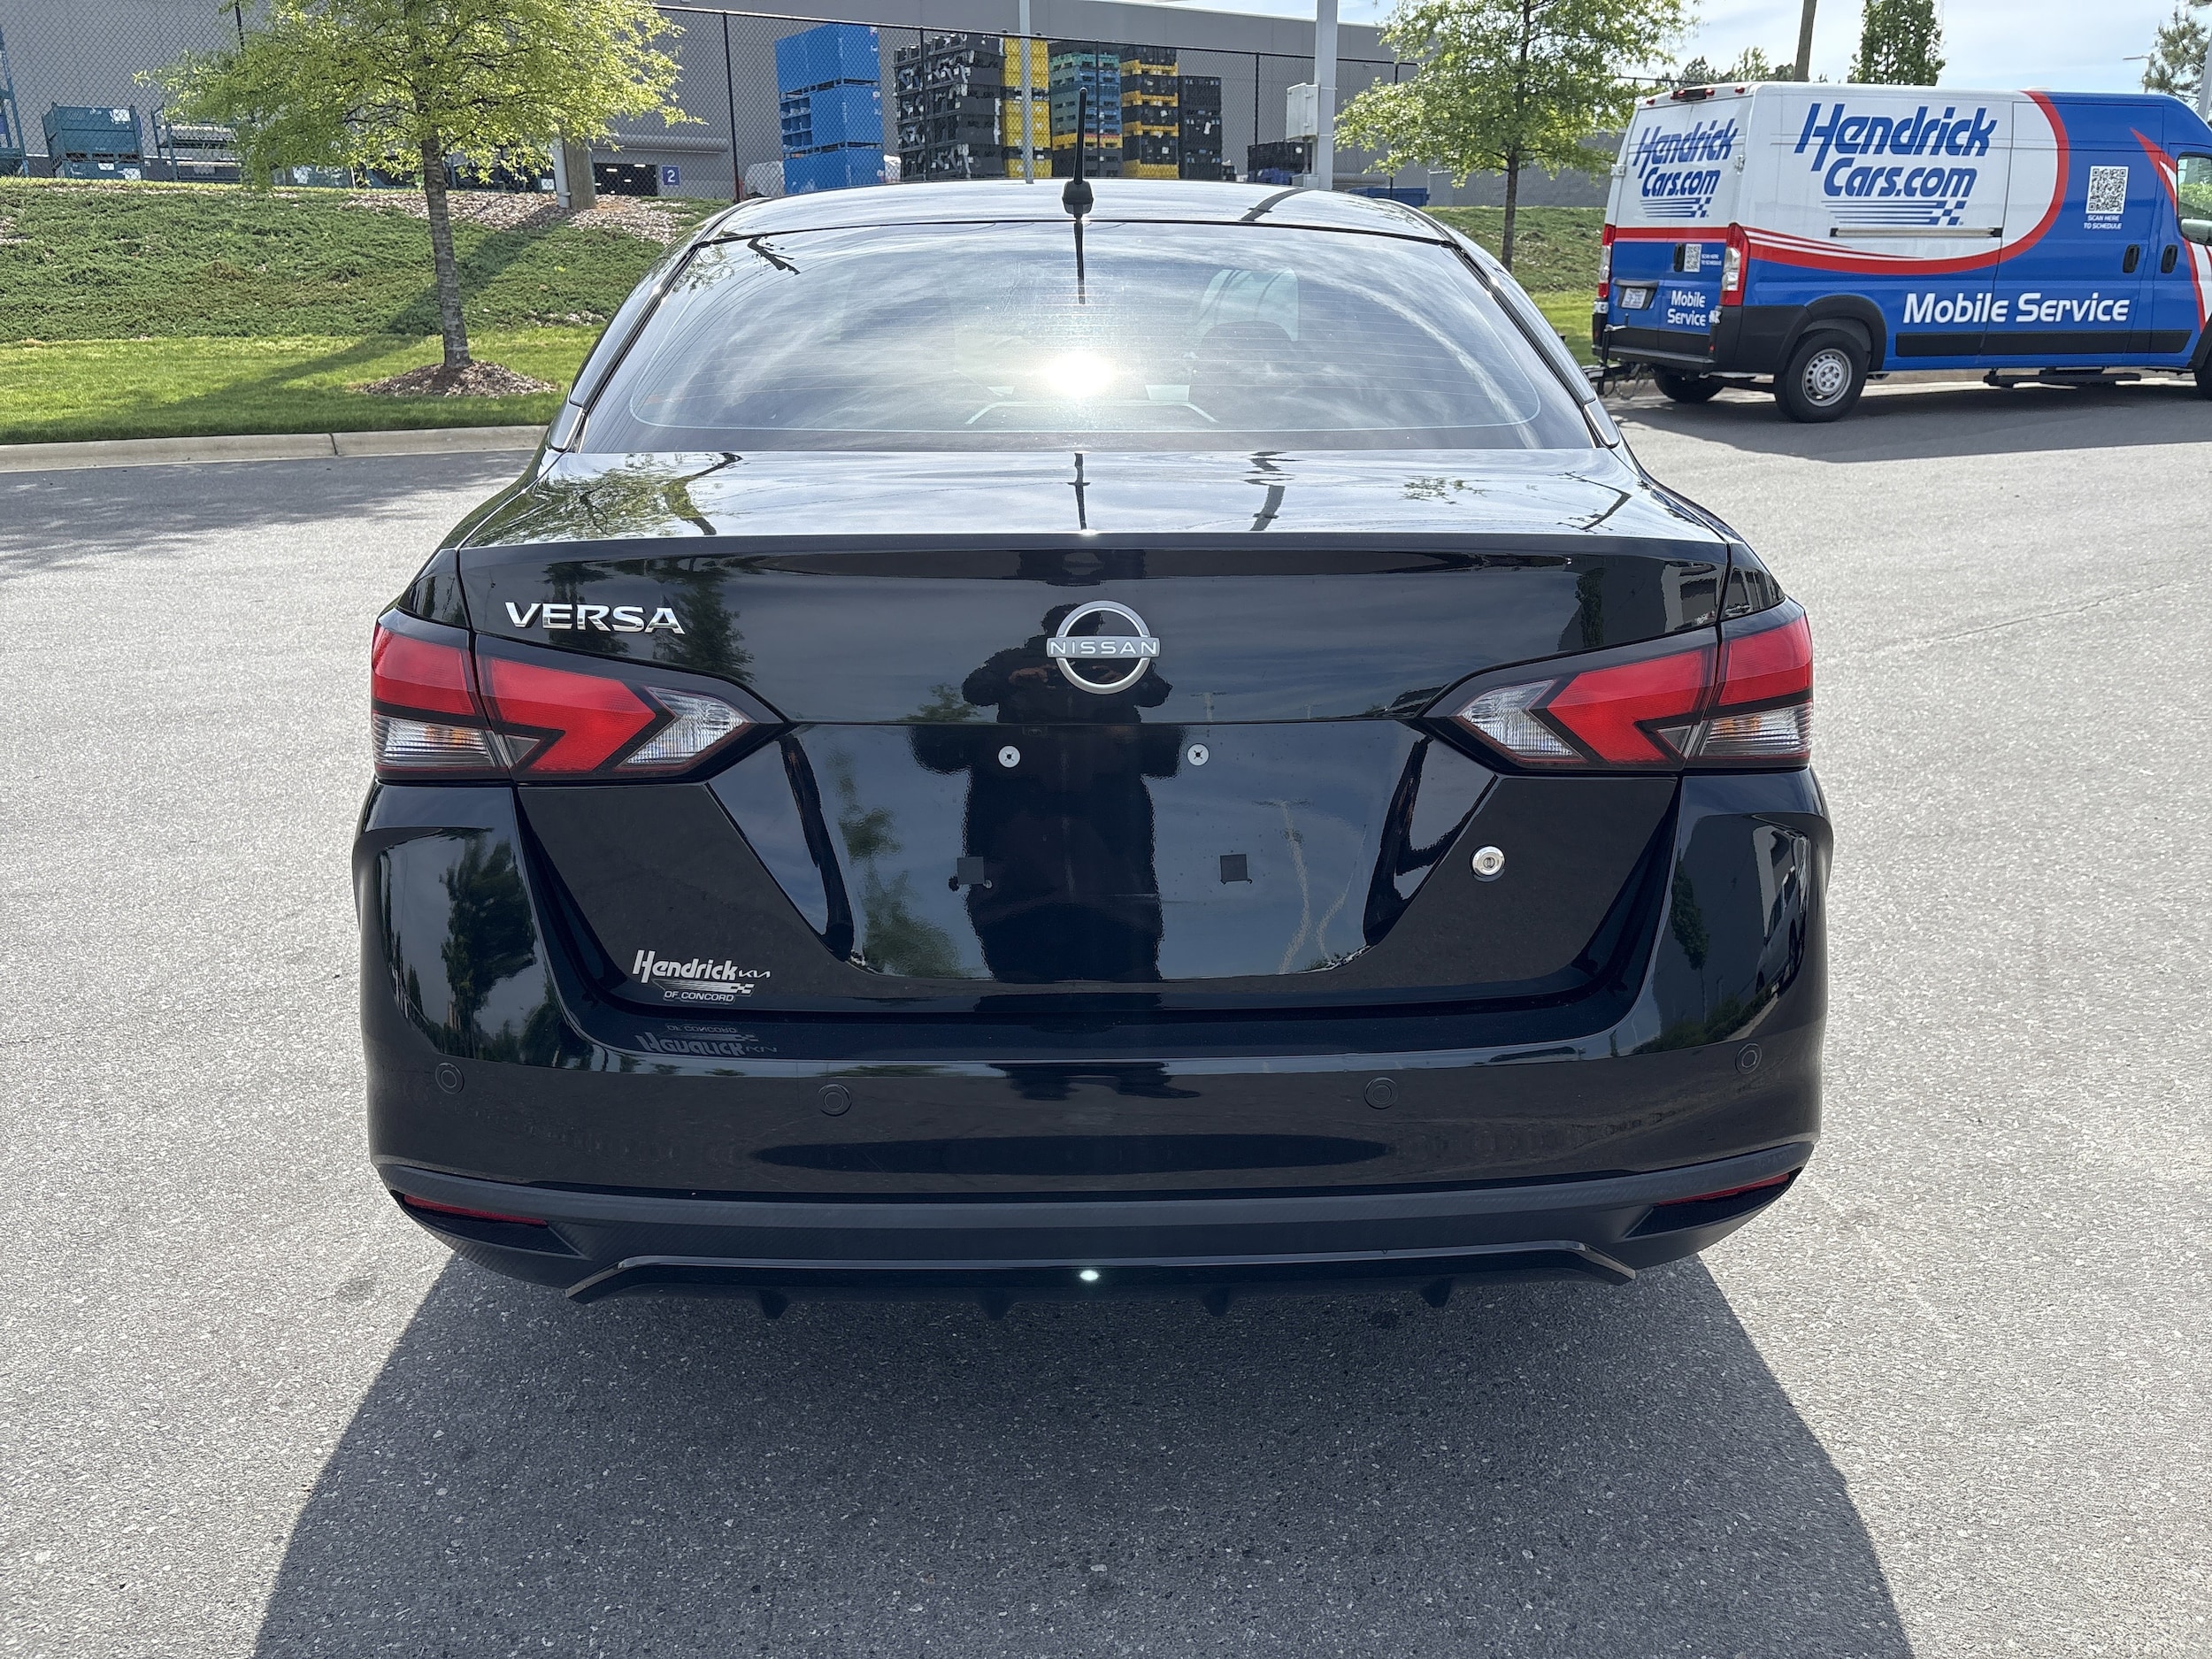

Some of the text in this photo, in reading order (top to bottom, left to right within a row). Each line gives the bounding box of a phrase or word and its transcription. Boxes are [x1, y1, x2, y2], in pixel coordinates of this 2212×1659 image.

[1632, 118, 1740, 179] Hendrick
[1793, 103, 1998, 172] Hendrick
[666, 169, 676, 183] 2
[1641, 166, 1721, 197] Cars.com
[1824, 157, 1978, 197] Cars.com
[1671, 289, 1707, 308] Mobile
[1902, 292, 2131, 324] Mobile Service
[1667, 308, 1707, 326] Service
[504, 602, 686, 635] VERSA
[1049, 641, 1157, 655] NISSAN
[632, 949, 738, 984] Hendrick
[664, 990, 735, 1002] OF CONCORD
